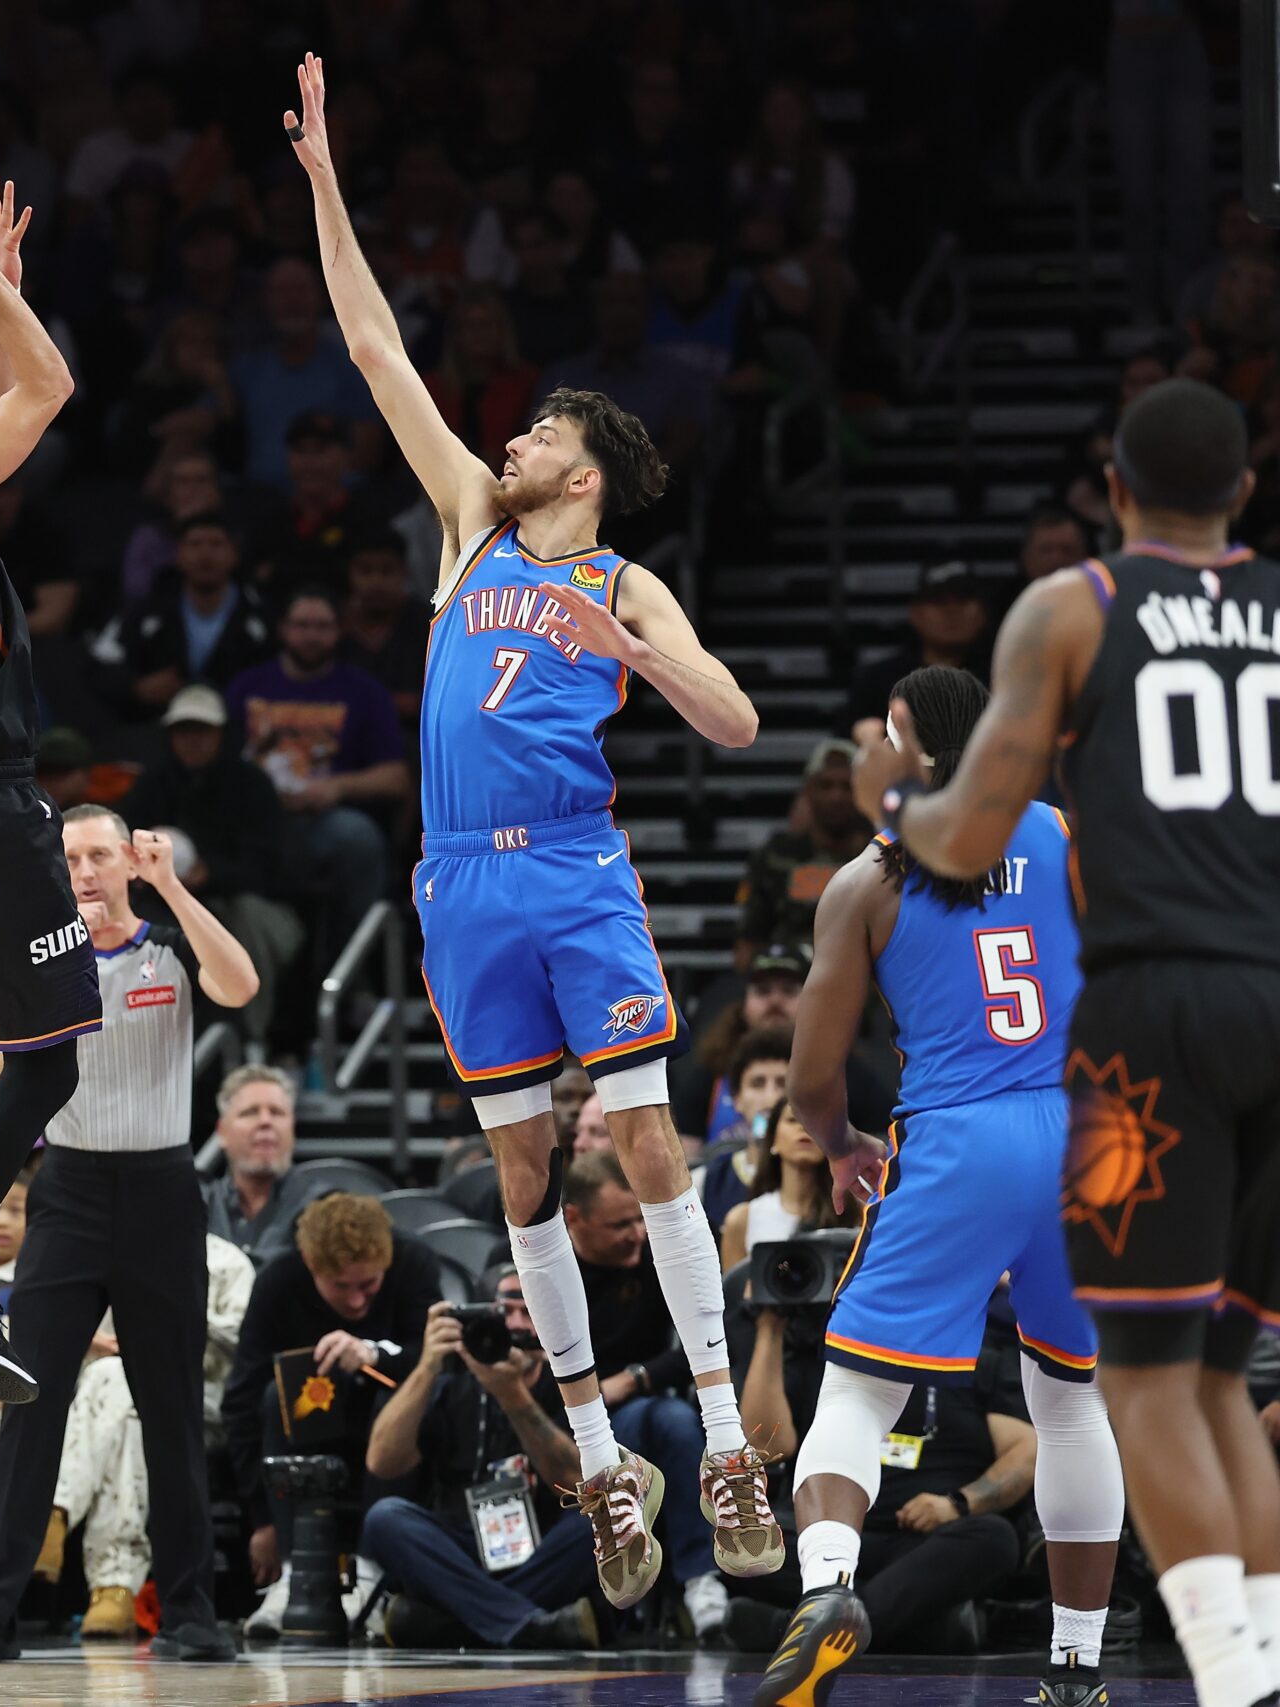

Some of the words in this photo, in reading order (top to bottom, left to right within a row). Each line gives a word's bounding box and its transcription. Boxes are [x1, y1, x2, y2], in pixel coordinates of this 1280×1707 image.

[480, 647, 529, 712] 7
[493, 827, 529, 851] OKC
[983, 856, 1030, 896] RT
[29, 914, 88, 965] SUNS
[128, 990, 176, 1007] Emirates
[973, 923, 1048, 1047] 5
[616, 1001, 644, 1031] OKC
